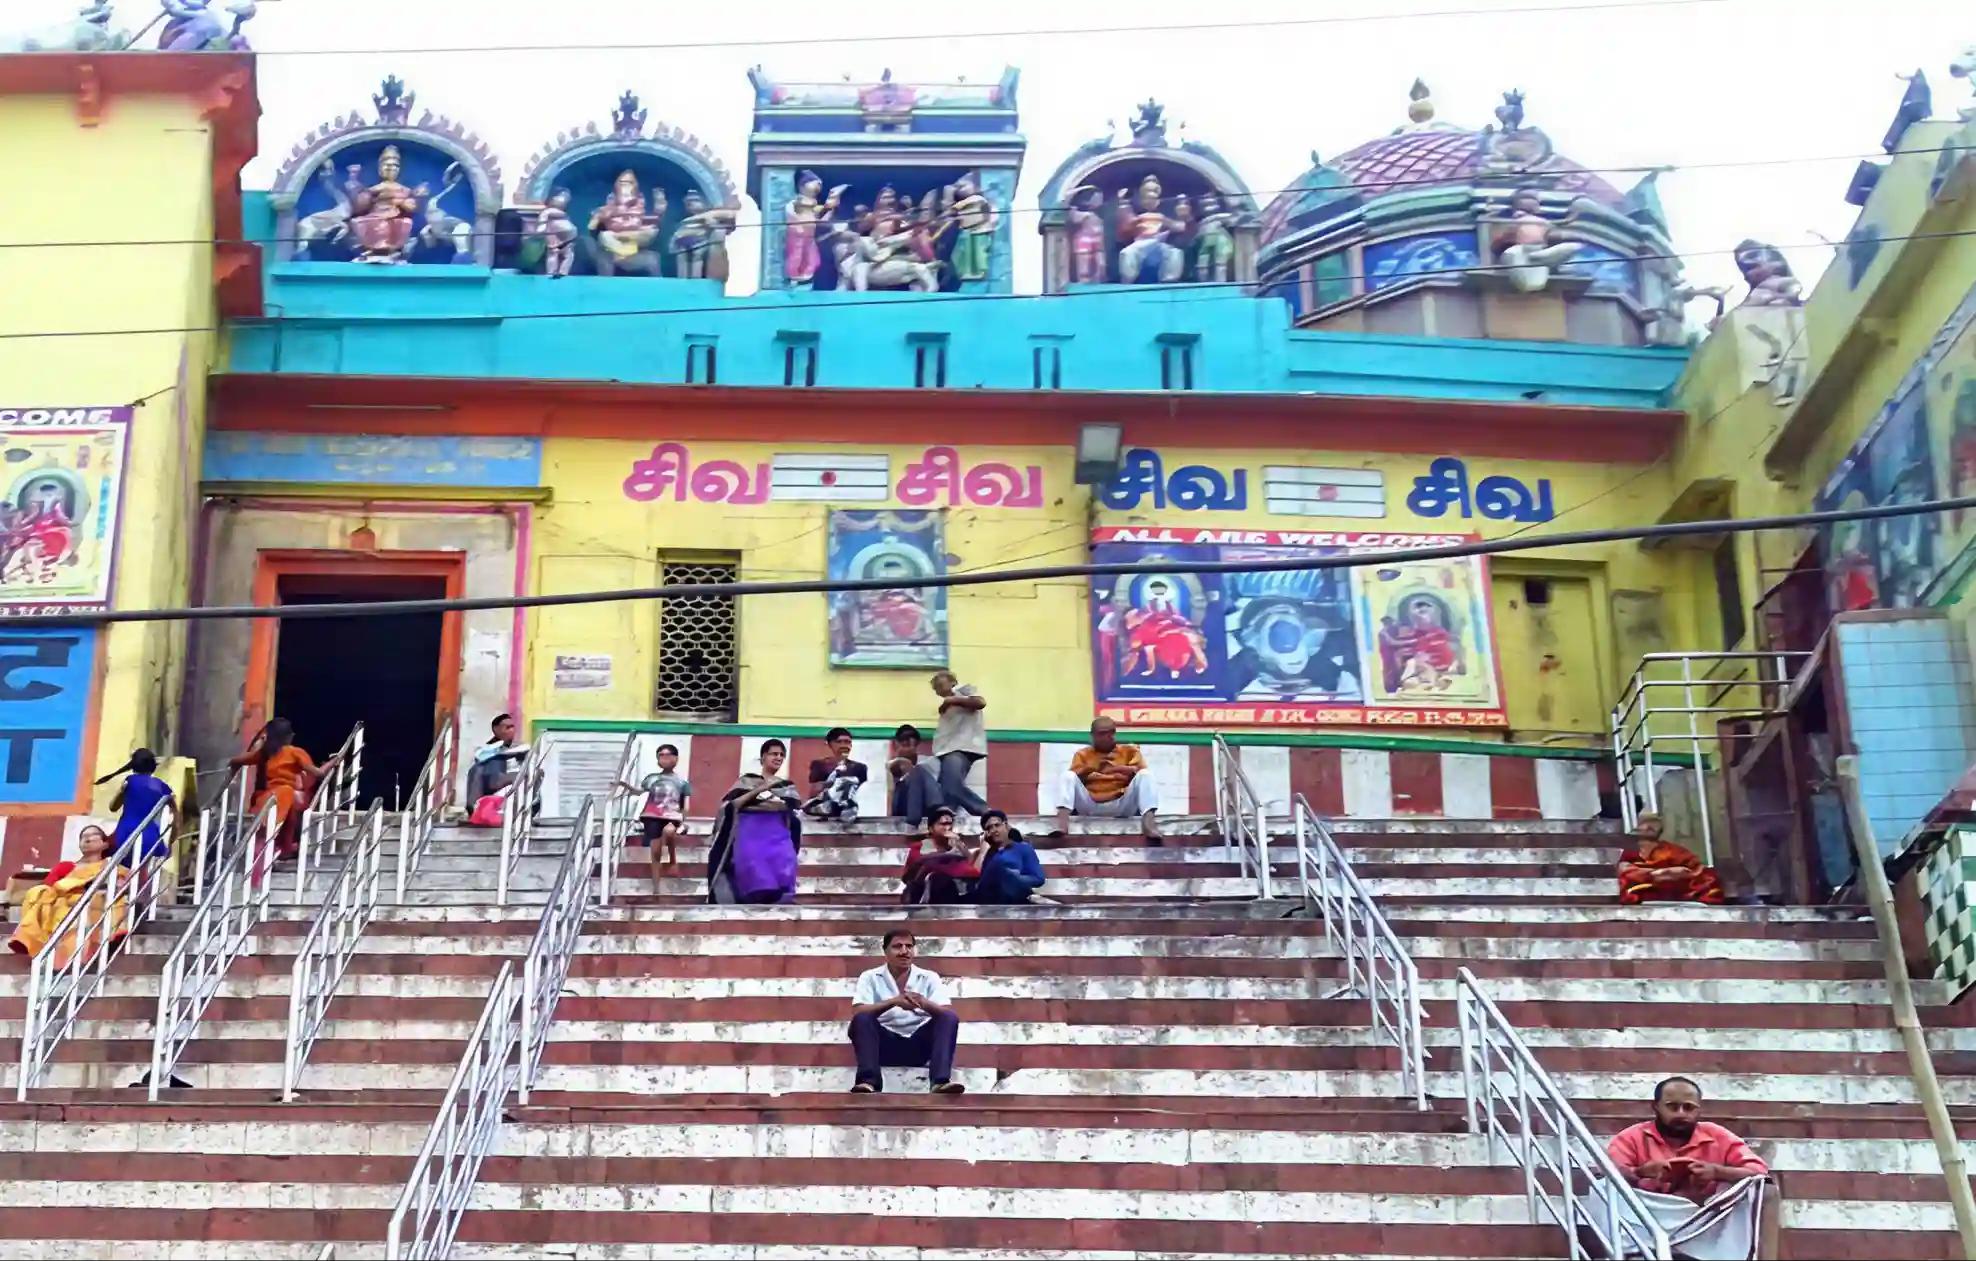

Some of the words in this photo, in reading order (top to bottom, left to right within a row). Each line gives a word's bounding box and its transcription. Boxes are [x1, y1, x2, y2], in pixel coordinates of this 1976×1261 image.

[622, 442, 772, 504] சிவ
[896, 446, 1043, 507] சிவ
[1099, 448, 1248, 511] சிவ
[1406, 457, 1555, 523] சிவ
